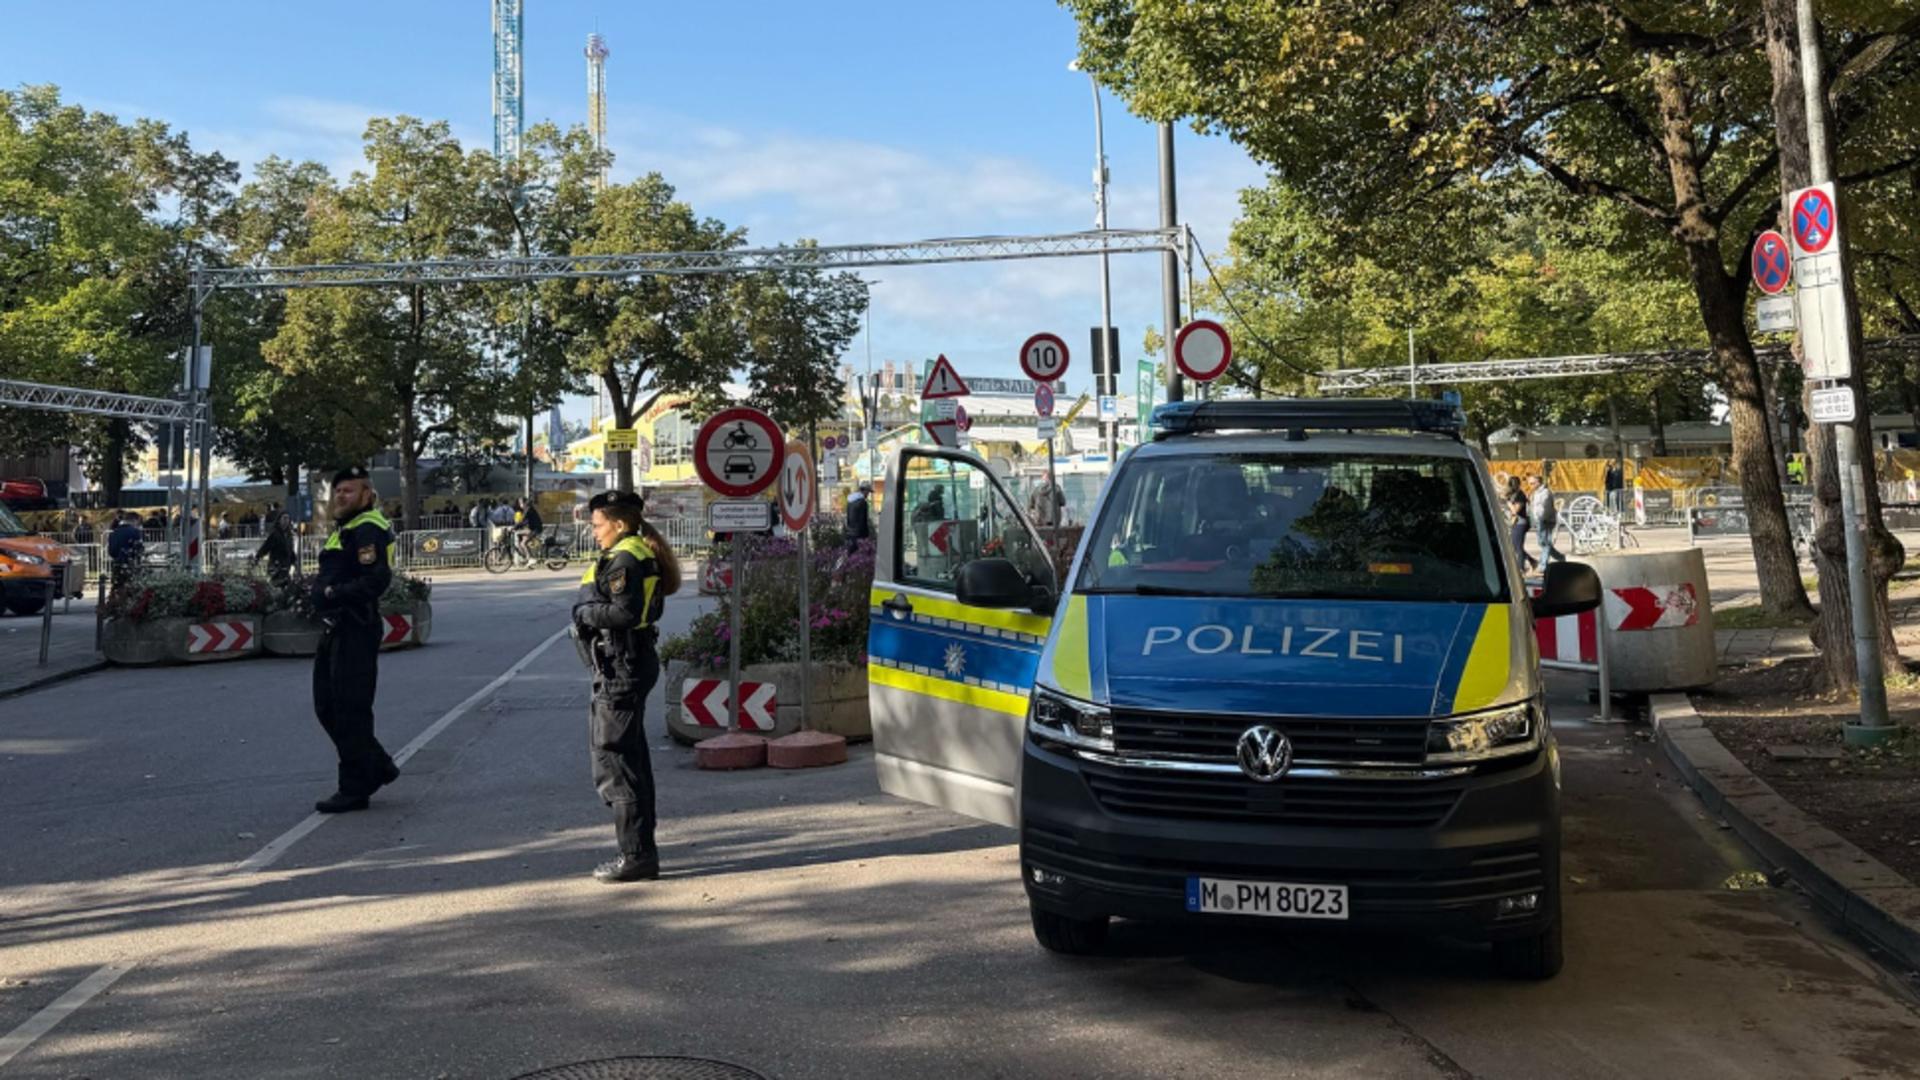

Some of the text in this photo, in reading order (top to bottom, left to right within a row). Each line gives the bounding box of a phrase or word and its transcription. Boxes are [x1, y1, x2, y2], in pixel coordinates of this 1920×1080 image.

[1033, 346, 1057, 369] 10
[1142, 625, 1403, 664] POLIZEI
[1202, 882, 1343, 914] M PM 8023
